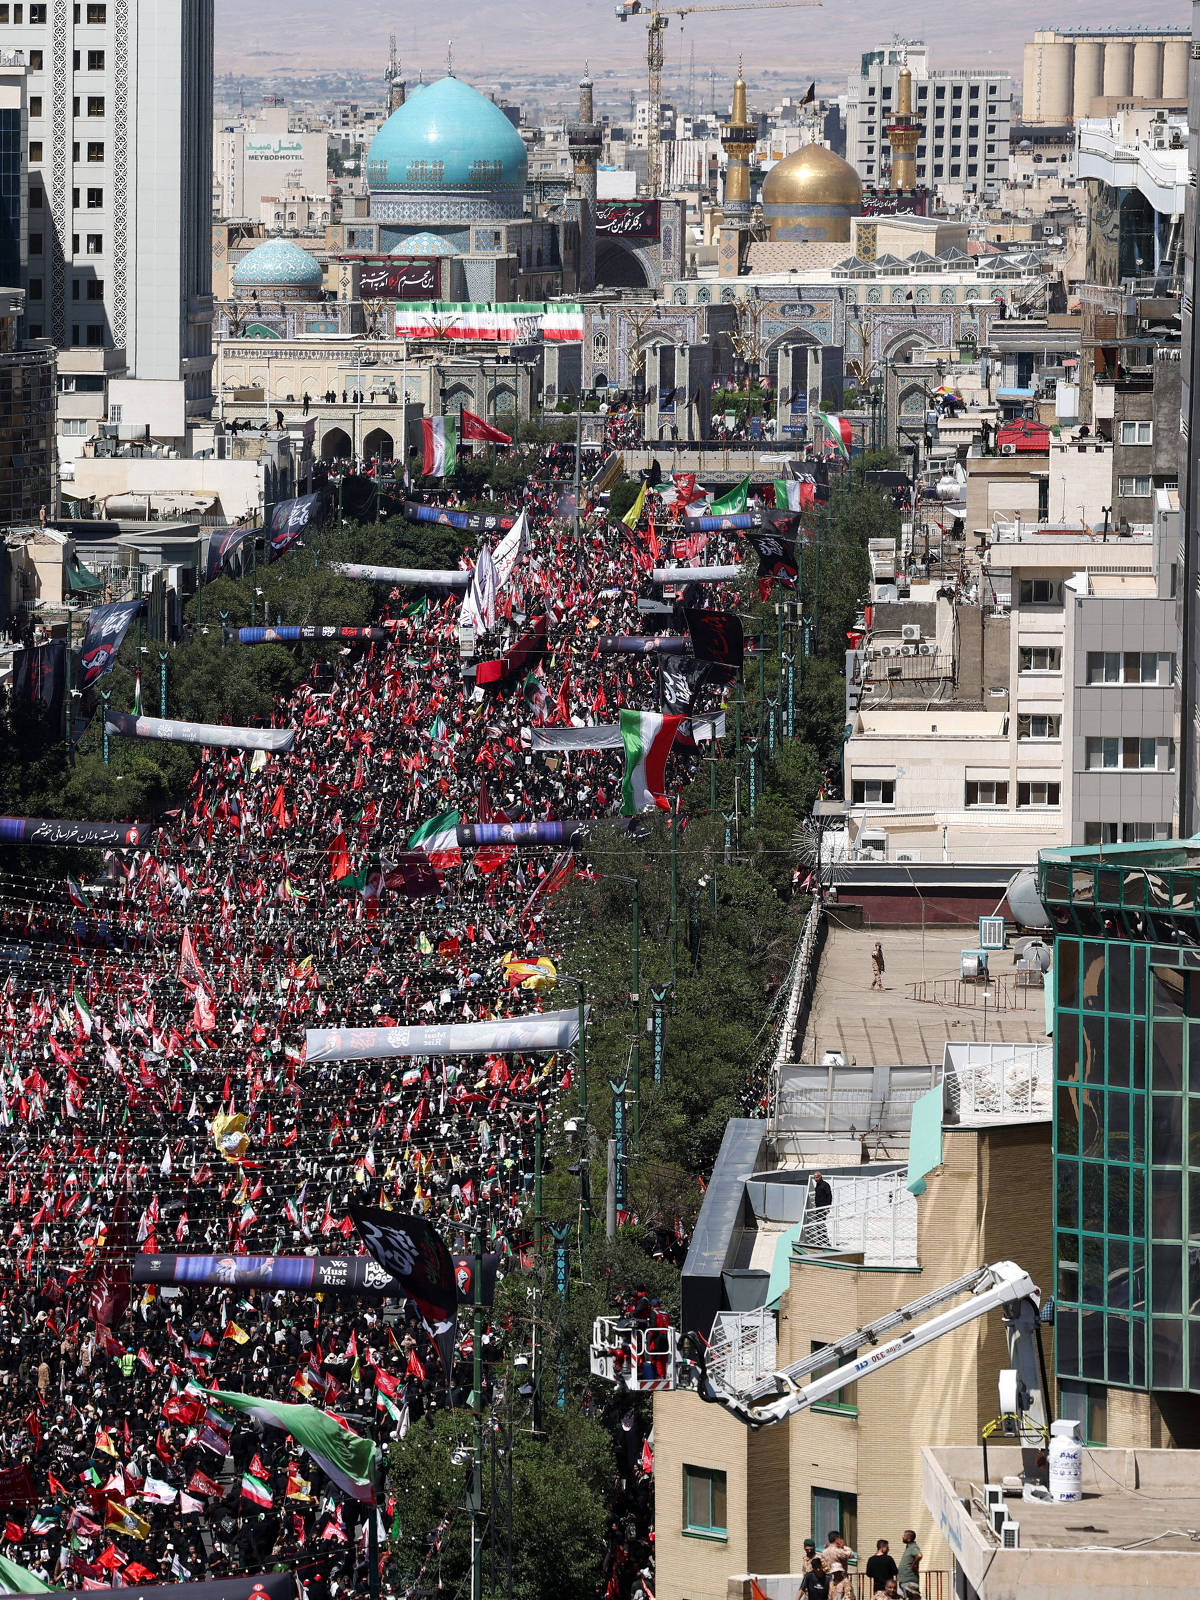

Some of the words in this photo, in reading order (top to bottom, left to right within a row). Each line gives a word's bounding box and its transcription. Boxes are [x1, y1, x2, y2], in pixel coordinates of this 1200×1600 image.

[319, 1266, 347, 1275] Must
[322, 1275, 347, 1285] Rise
[871, 1351, 886, 1363] 330
